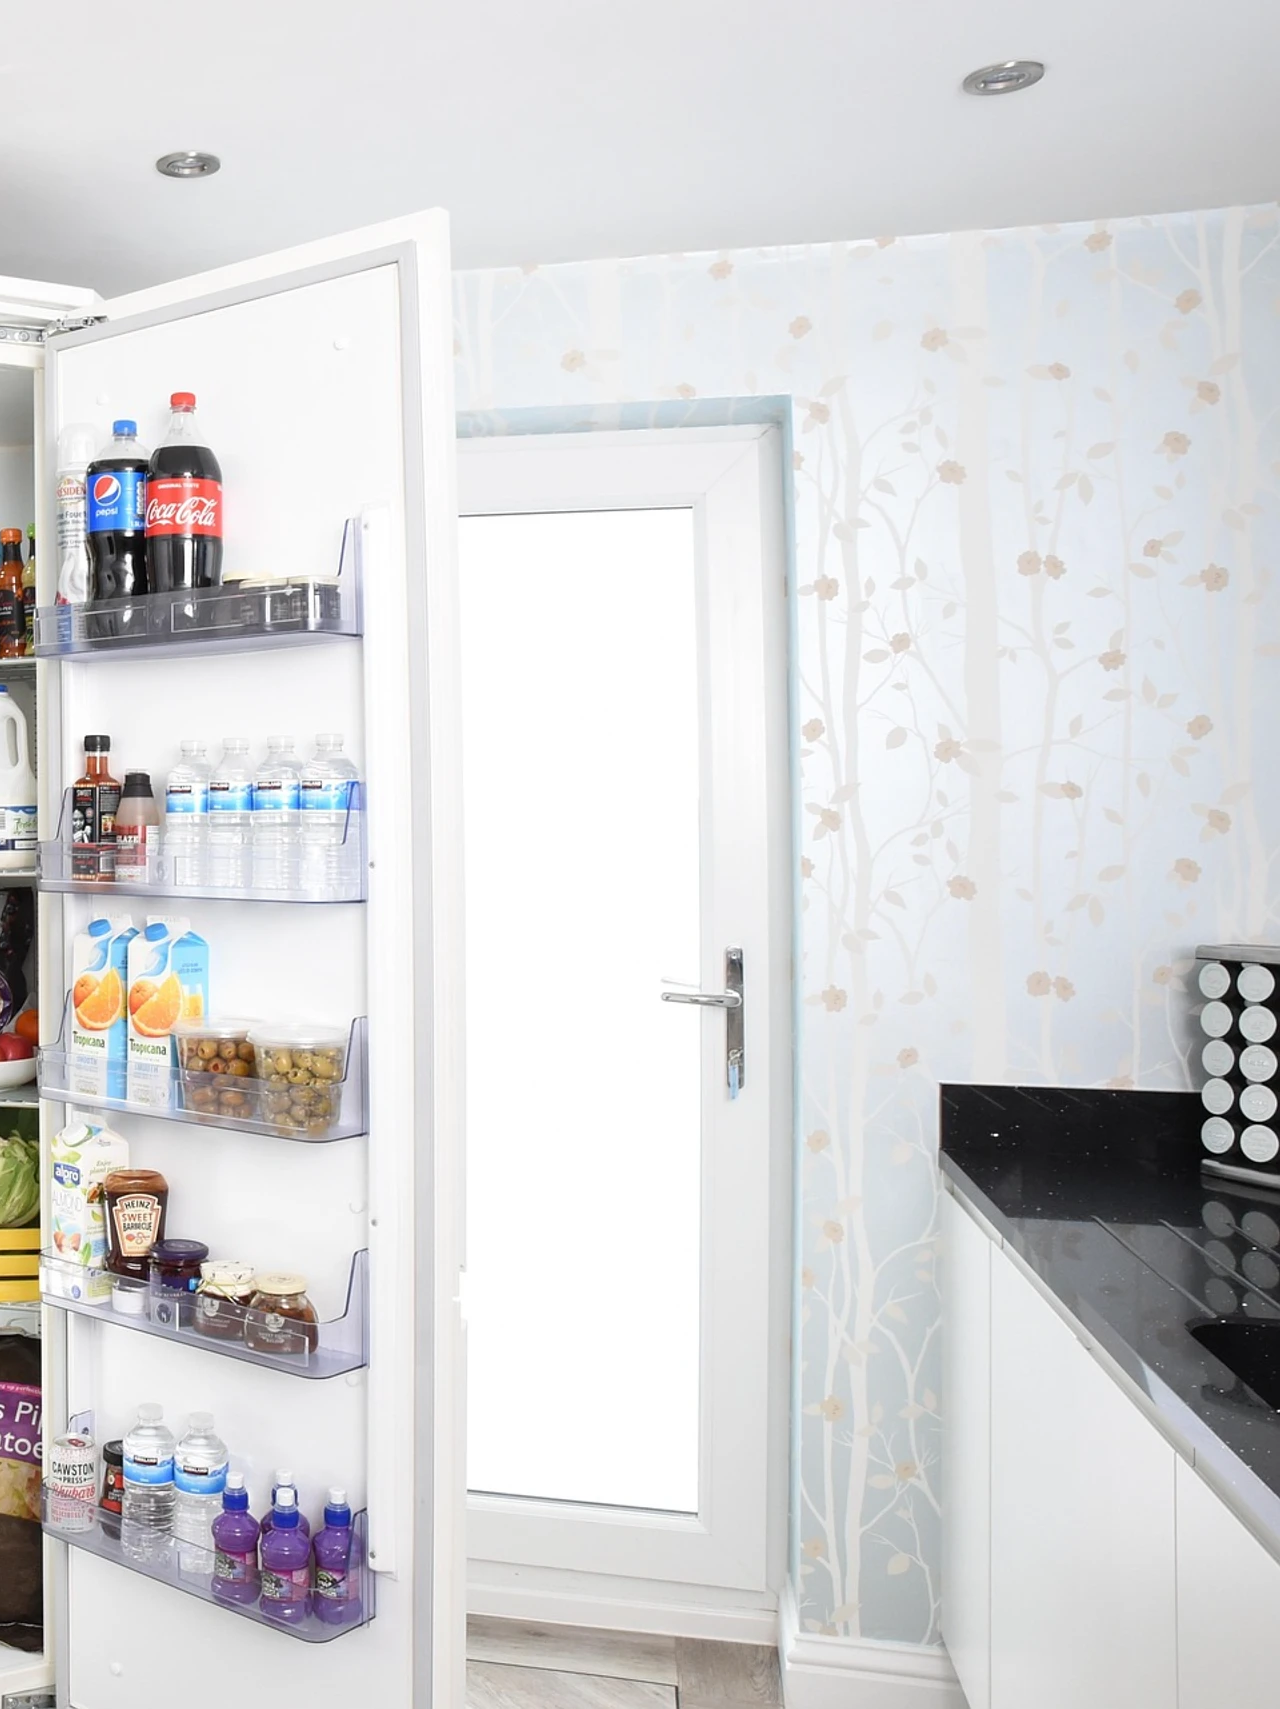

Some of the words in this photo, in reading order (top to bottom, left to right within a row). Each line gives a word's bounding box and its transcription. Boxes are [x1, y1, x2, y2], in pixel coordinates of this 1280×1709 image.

[95, 507, 118, 517] pepsi
[146, 496, 217, 527] Coca-Cola
[73, 1030, 105, 1048] Tropicana
[129, 1038, 167, 1055] Tropicana
[55, 1164, 78, 1182] alpro
[124, 1200, 150, 1209] HEINZ
[121, 1213, 153, 1221] SWEET
[122, 1222, 152, 1232] BARBECUE
[52, 1461, 94, 1476] CAWSTON
[51, 1483, 95, 1498] Rhubarb
